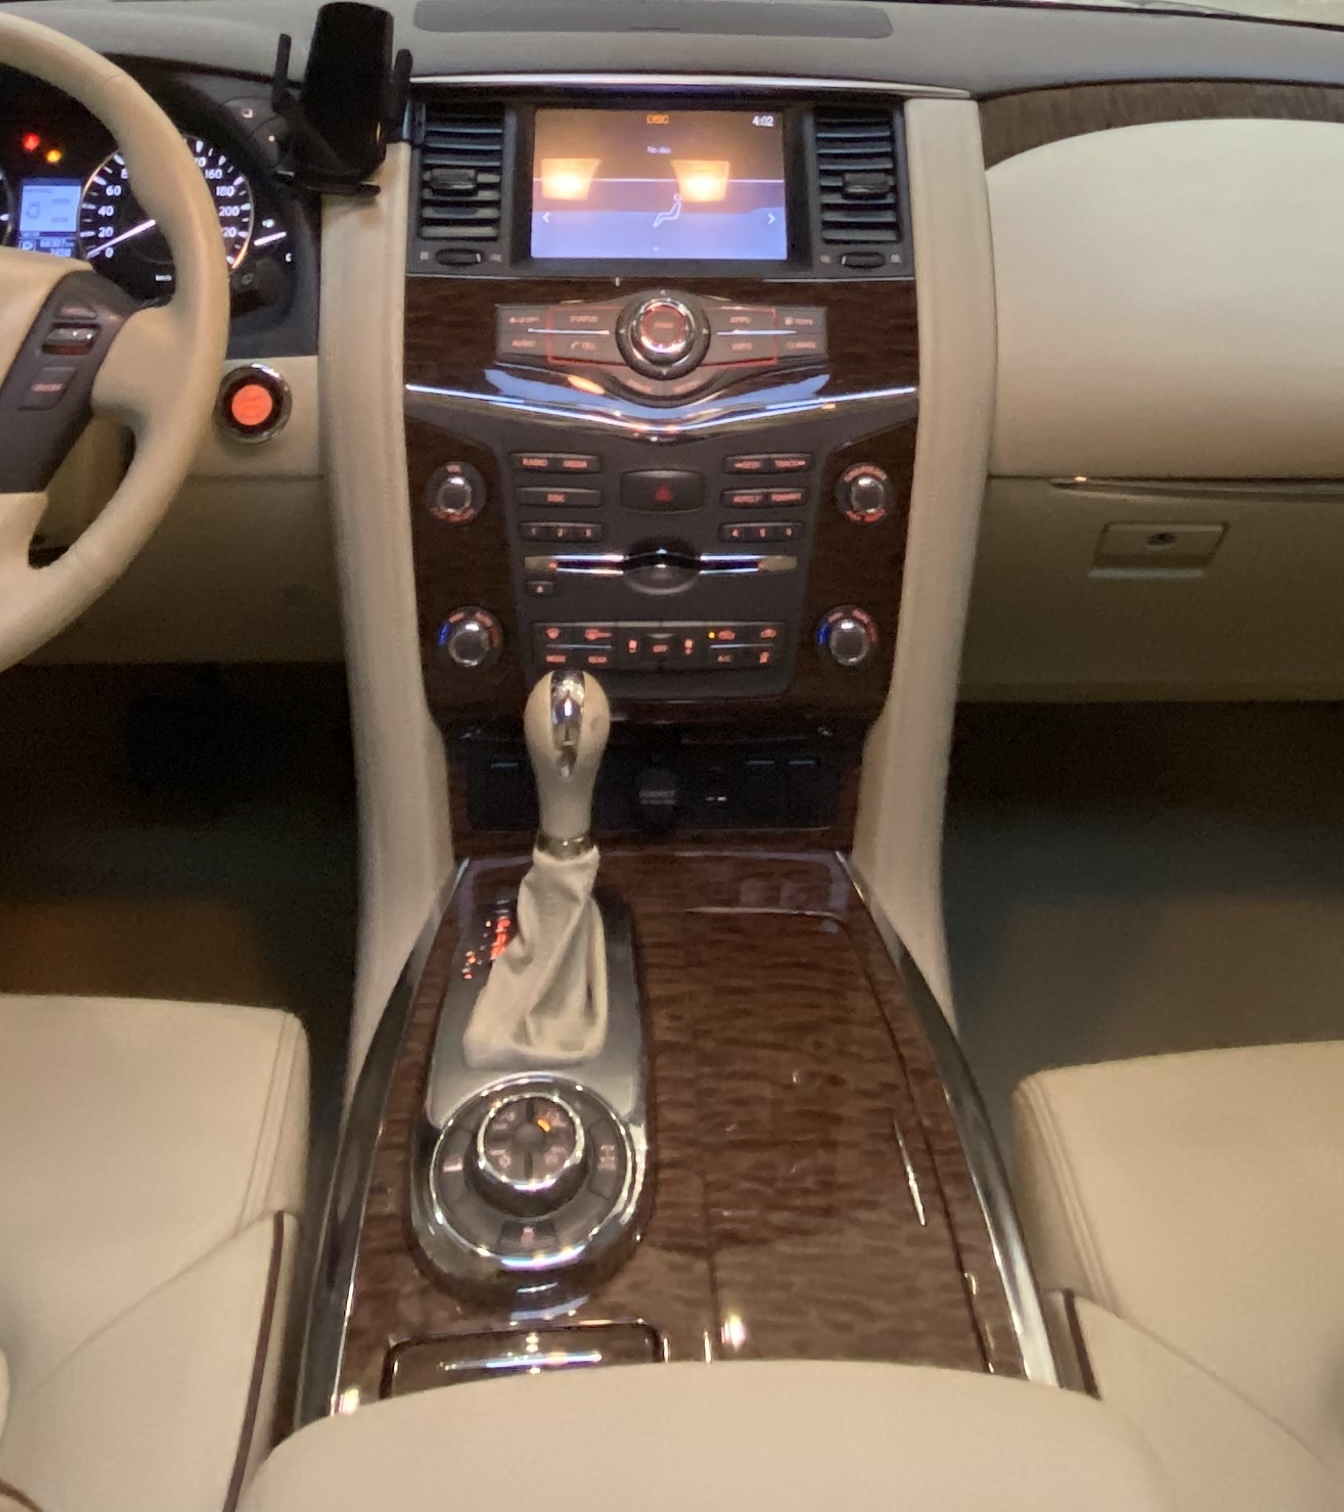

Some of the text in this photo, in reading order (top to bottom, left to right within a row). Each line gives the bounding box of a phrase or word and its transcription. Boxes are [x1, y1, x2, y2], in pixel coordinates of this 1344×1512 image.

[752, 115, 774, 127] 4:02
[205, 169, 222, 179] 160
[106, 186, 121, 196] 60
[216, 186, 235, 197] 180
[98, 206, 114, 216] 40
[219, 206, 240, 217] 200
[98, 226, 114, 237] 20
[105, 248, 114, 258] 0
